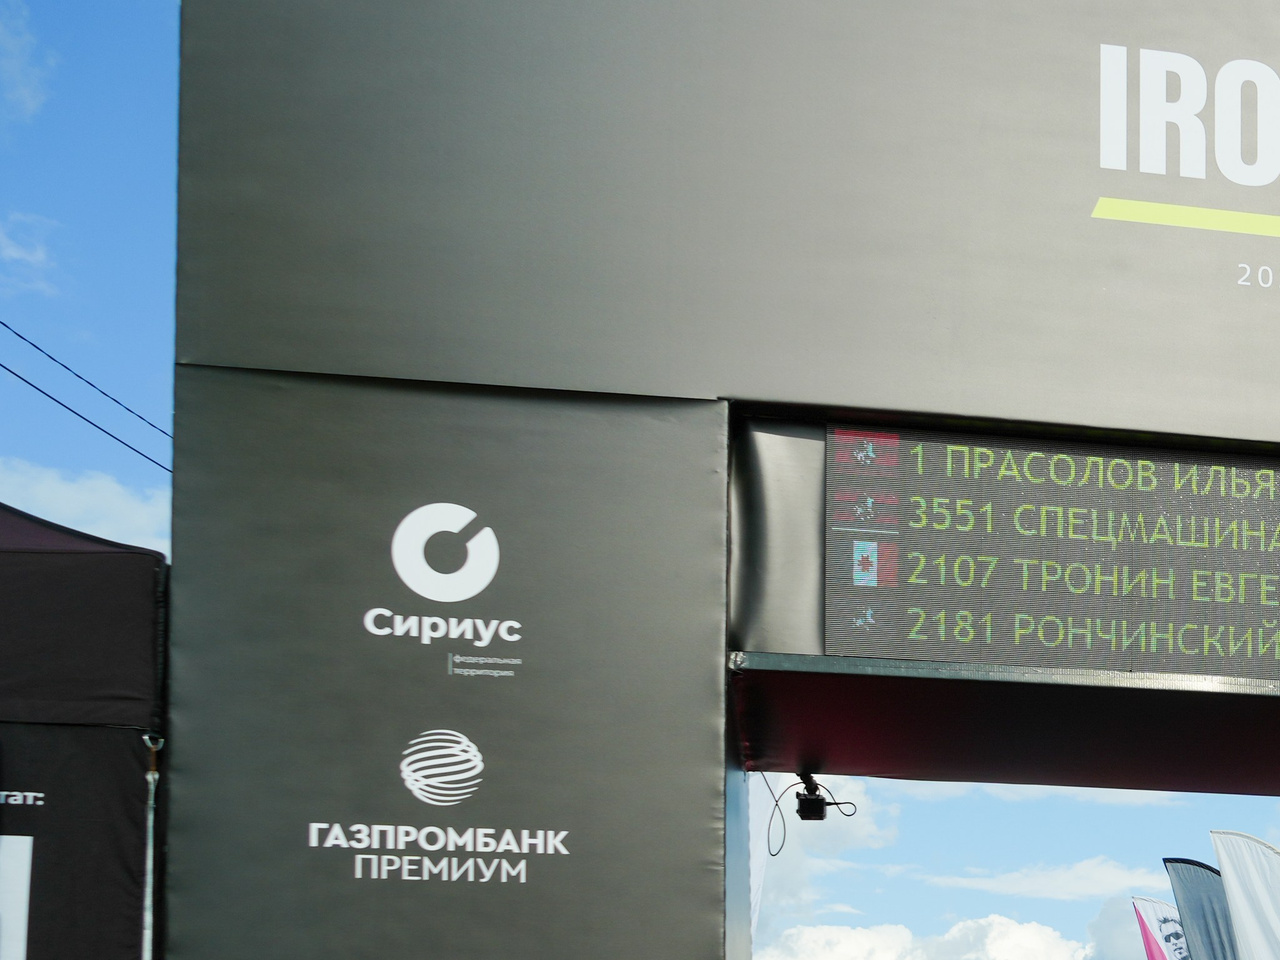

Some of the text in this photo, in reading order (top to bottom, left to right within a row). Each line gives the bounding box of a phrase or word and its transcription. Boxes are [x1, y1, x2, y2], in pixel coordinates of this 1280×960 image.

[909, 443, 925, 476] 1
[945, 444, 1158, 493] ПРАСОЛОВ
[1173, 461, 1277, 500] ИЛЬЯ
[907, 496, 995, 534] 3551
[907, 552, 998, 588] 2107
[1012, 557, 1175, 600] ТРОНИН
[363, 607, 523, 648] Сириус
[907, 607, 994, 643] 2181
[307, 822, 572, 856] ГАЗПРОМБАНК
[353, 854, 528, 884] ПРЕМИУМ
